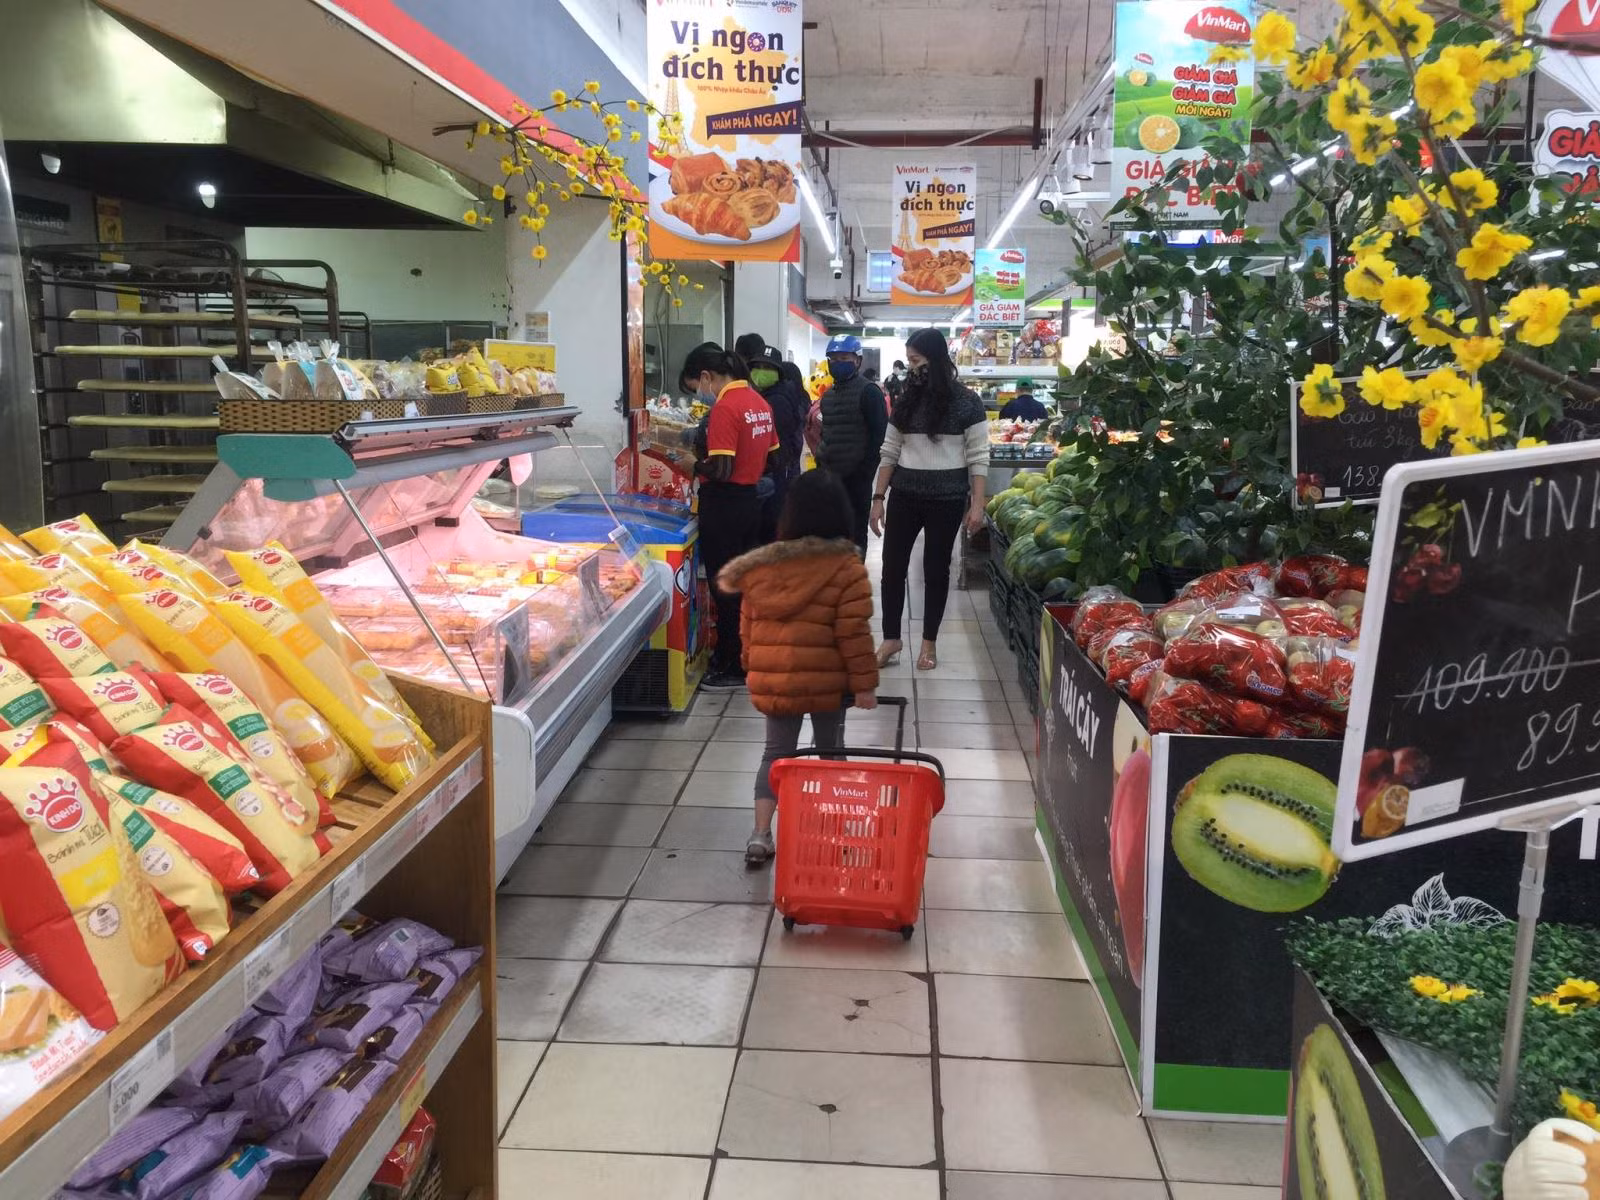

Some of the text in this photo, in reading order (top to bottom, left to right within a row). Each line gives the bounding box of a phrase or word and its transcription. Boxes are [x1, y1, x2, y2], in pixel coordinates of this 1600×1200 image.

[1196, 11, 1247, 33] VinMart
[670, 20, 784, 55] Vị ngon
[662, 53, 800, 91] đích thực
[1212, 69, 1238, 86] GIÁ
[1211, 88, 1237, 105] GIÁ
[711, 109, 798, 130] KHÁM PHÁ NGAY!
[896, 165, 929, 175] VinMart
[1125, 155, 1166, 180] GIÁ
[905, 181, 966, 197] Vị ngon
[900, 197, 975, 214] đích thực
[948, 223, 973, 234] NGAY!
[1059, 663, 1100, 760] TRÁI CÂY
[832, 786, 868, 797] VinMart
